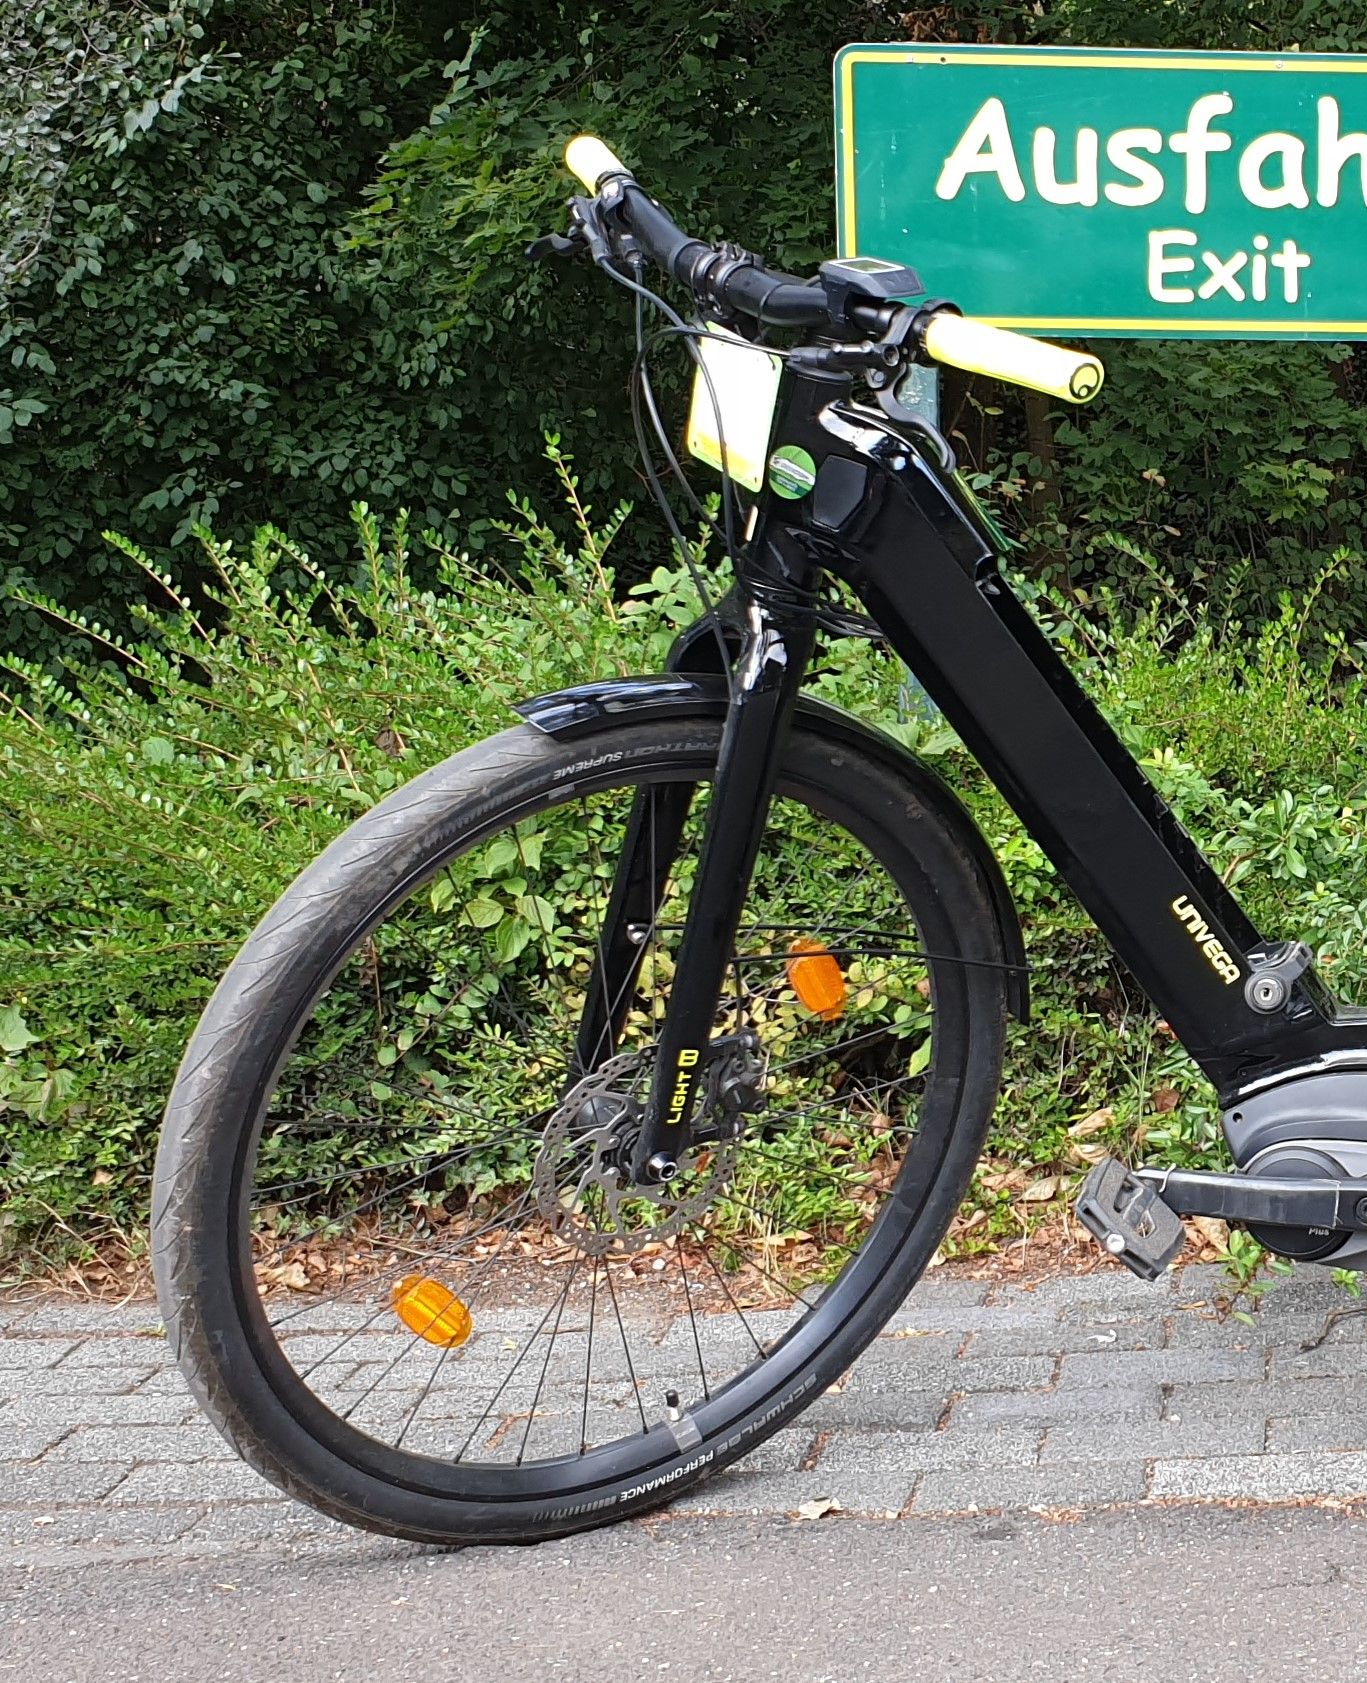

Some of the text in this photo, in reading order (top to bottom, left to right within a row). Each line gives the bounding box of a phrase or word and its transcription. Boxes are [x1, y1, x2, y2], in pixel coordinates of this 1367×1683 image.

[1146, 228, 1312, 304] Exit
[552, 750, 623, 781] SUPREME
[1171, 894, 1241, 985] UNIVEGA
[666, 1071, 692, 1124] LIGHT
[619, 1373, 818, 1503] SCHWALBE PERFORMANCE
